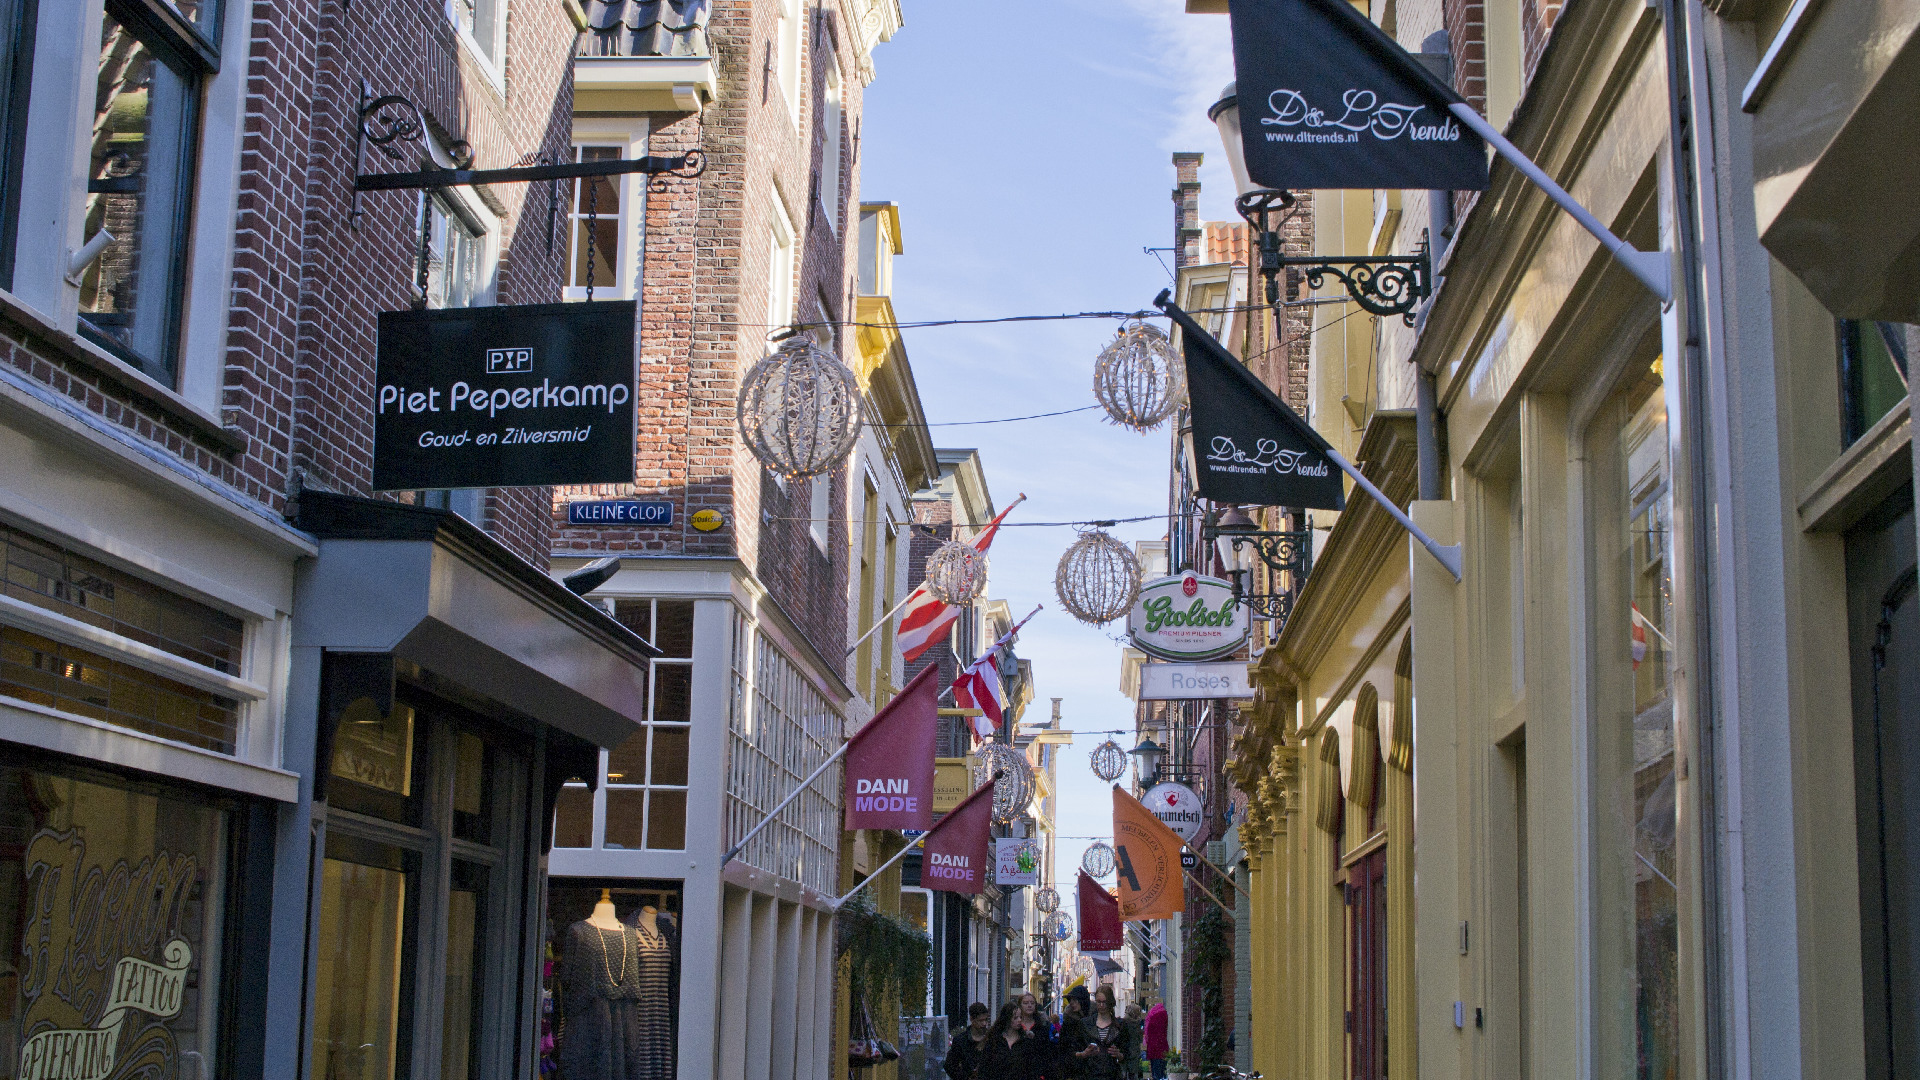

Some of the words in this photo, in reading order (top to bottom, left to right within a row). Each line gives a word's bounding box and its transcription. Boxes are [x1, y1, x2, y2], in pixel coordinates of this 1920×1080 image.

[1371, 102, 1460, 142] Trends
[1265, 131, 1359, 144] www.dltrends.nl
[379, 384, 440, 415] Piet
[450, 378, 630, 418] Peperkamp
[418, 429, 472, 448] Goud-
[476, 433, 498, 446] en
[501, 425, 592, 445] Zilversmid
[1209, 464, 1267, 475] www.dltrends.nl
[1273, 449, 1329, 477] Trends
[575, 503, 625, 521] KLEINE
[628, 504, 666, 520] GLOP
[1143, 596, 1236, 633] Grolsch
[1171, 672, 1230, 689] Roses
[856, 778, 909, 795] DANI
[855, 796, 918, 813] MODE
[930, 852, 969, 868] DANI
[929, 865, 975, 881] MODE
[115, 960, 181, 1012] TATTOO
[31, 1031, 114, 1080] PIERCING
